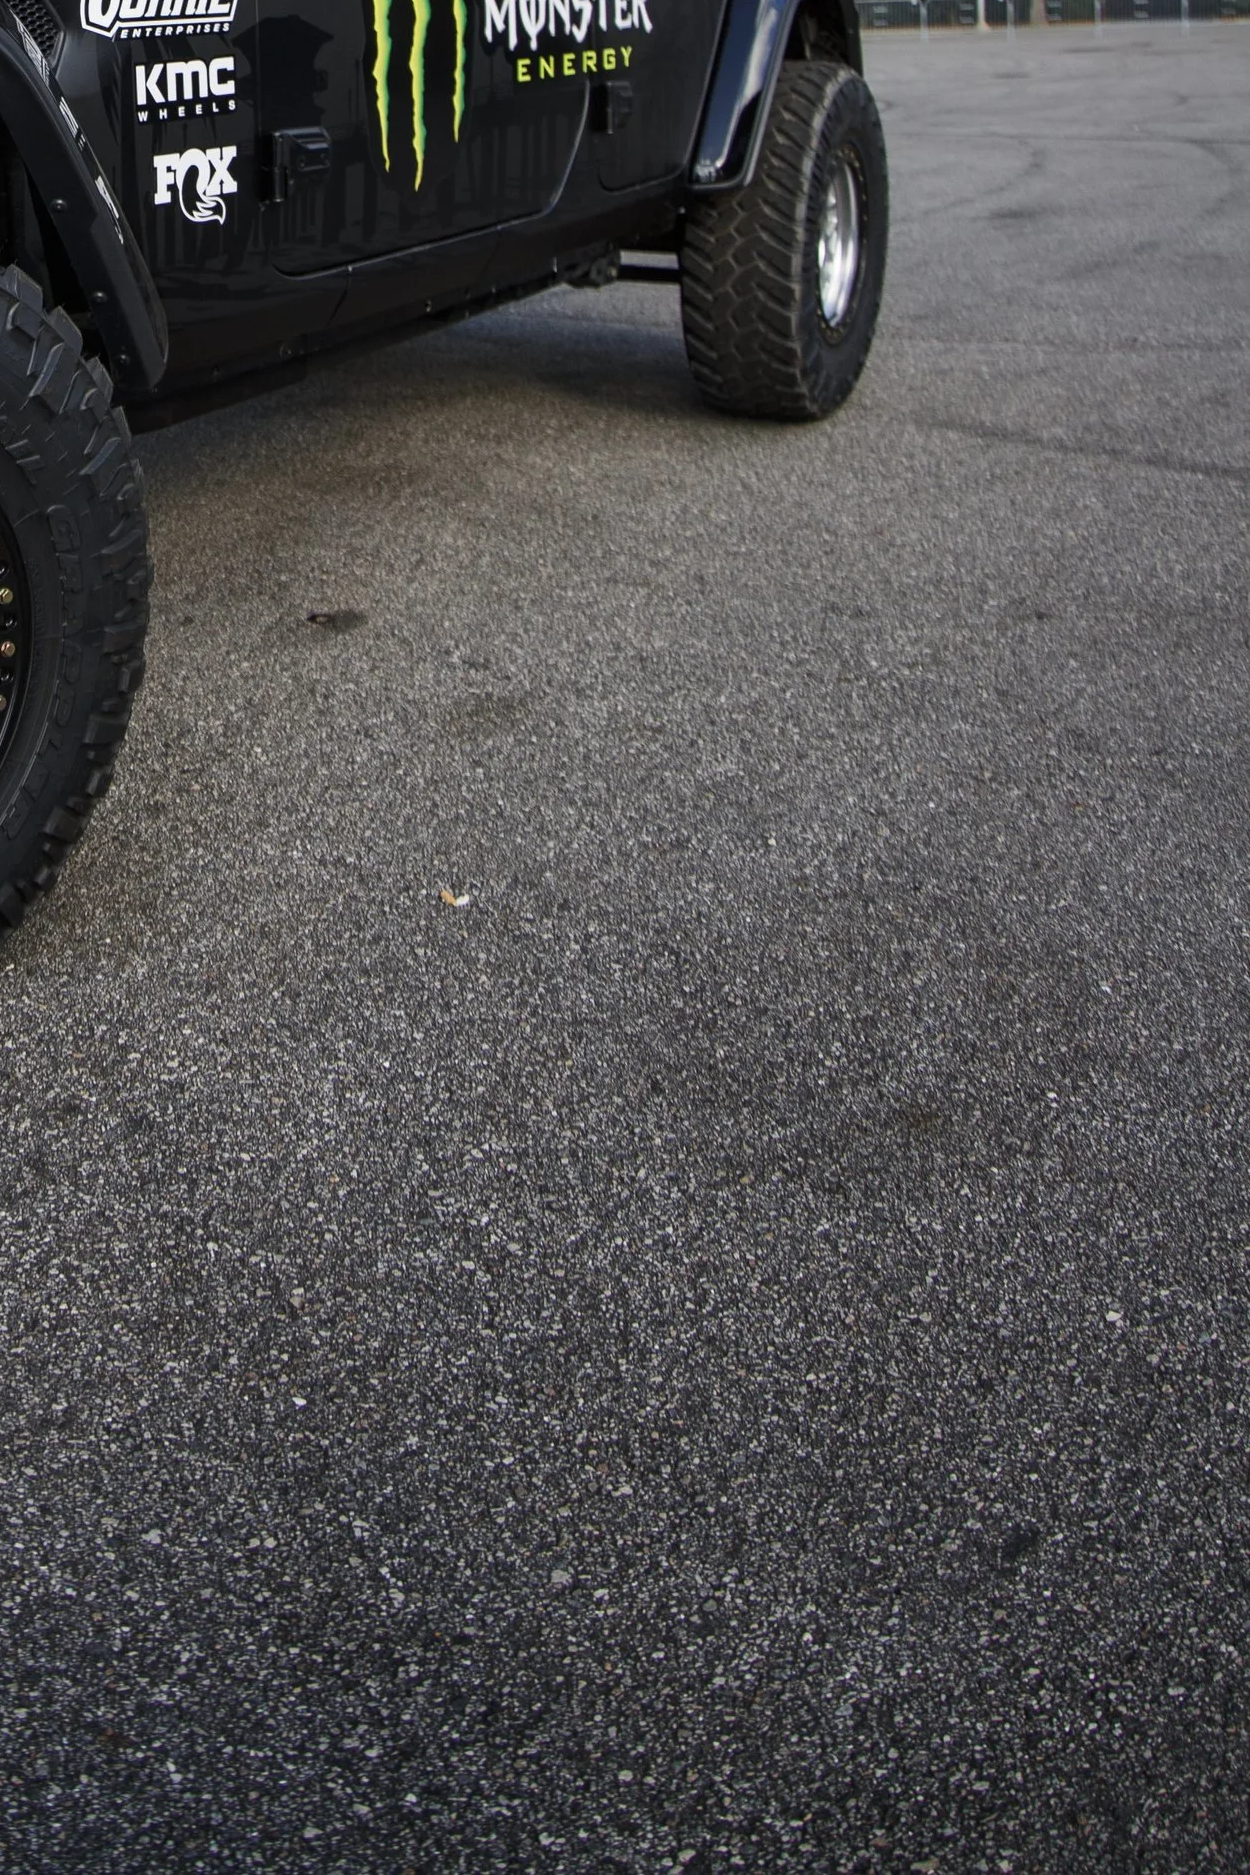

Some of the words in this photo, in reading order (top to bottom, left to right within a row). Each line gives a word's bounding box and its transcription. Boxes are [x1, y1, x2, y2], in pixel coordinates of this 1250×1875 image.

[120, 22, 231, 39] ENTERPRISES
[135, 56, 236, 106] KMC
[517, 46, 632, 82] ENERGY
[138, 100, 236, 123] WHEELS
[153, 145, 238, 225] FOX
